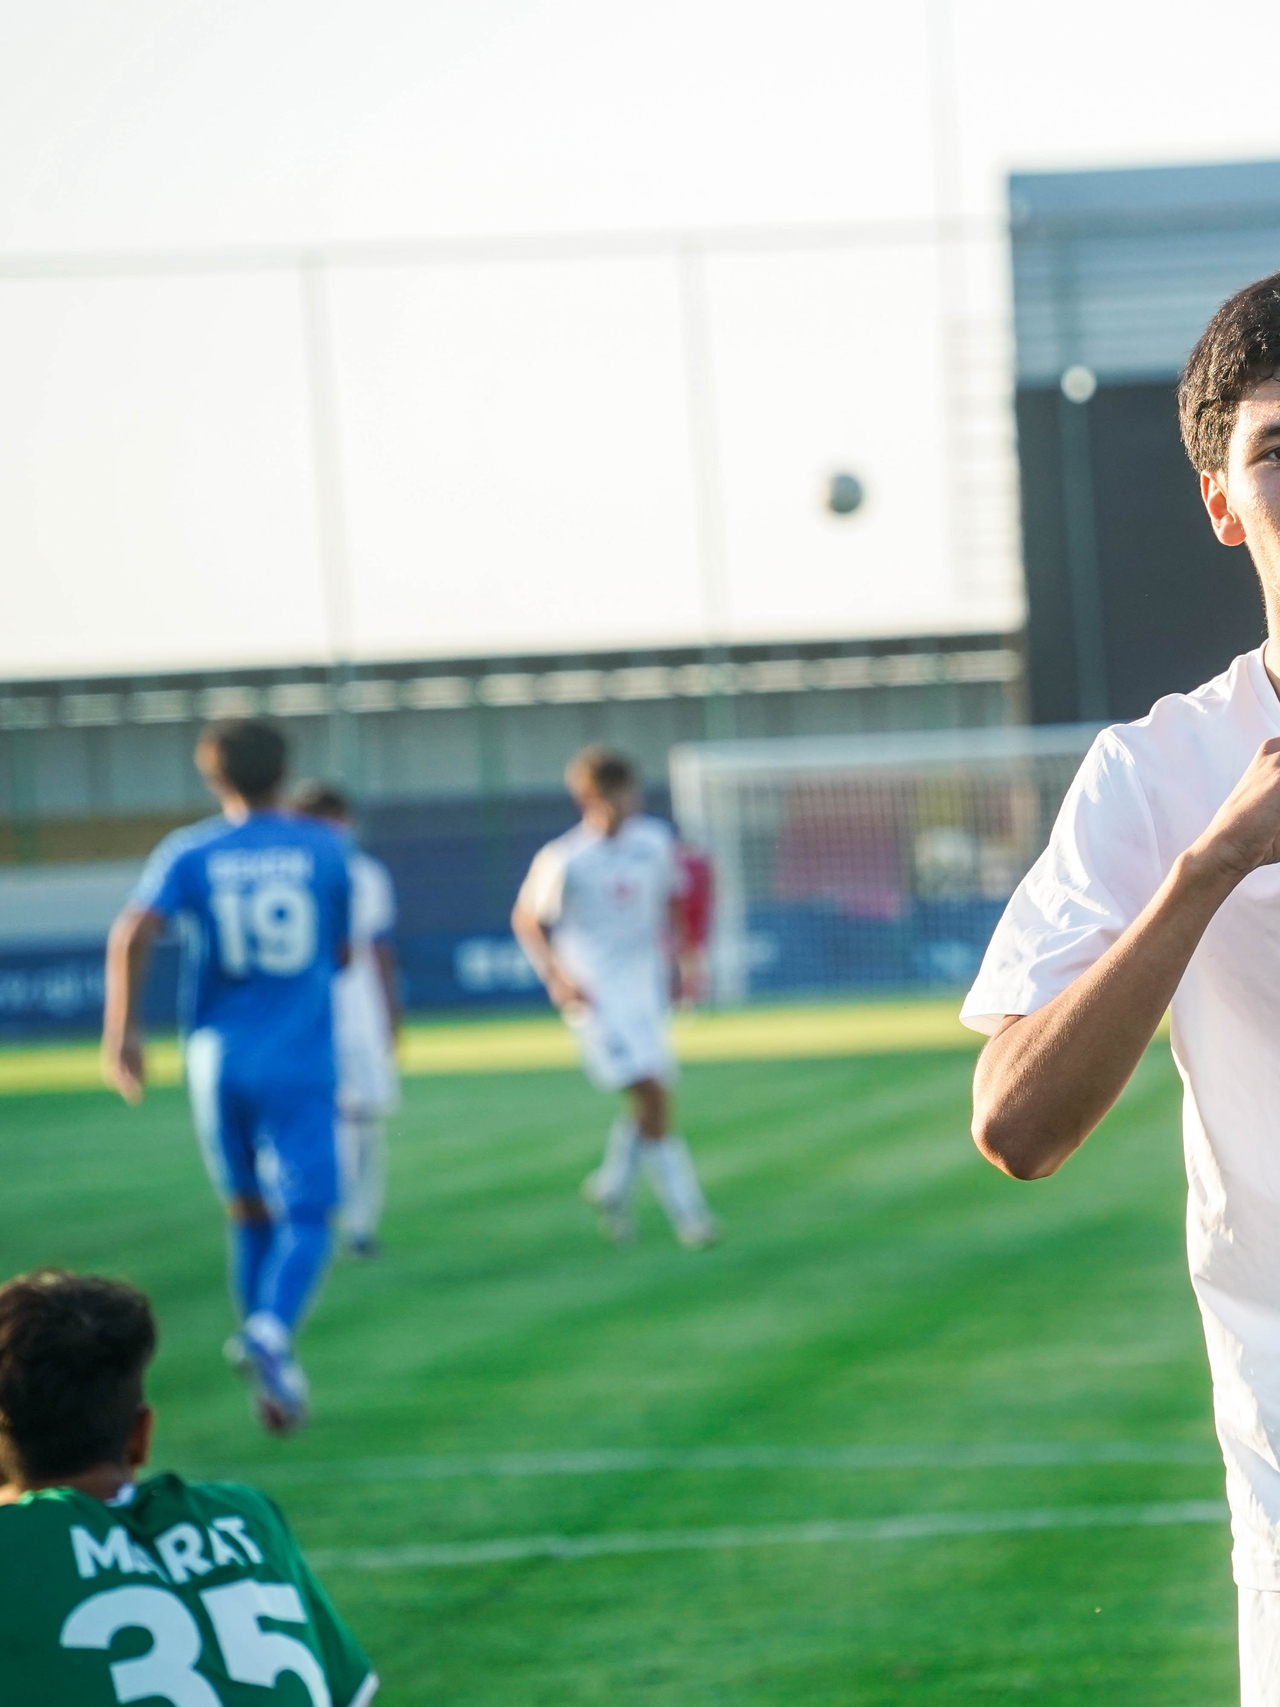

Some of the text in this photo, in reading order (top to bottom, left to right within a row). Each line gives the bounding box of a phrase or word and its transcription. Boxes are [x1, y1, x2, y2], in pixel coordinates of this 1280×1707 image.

[209, 886, 319, 976] 19
[69, 1516, 264, 1585] MARAT
[60, 1579, 333, 1707] 35
